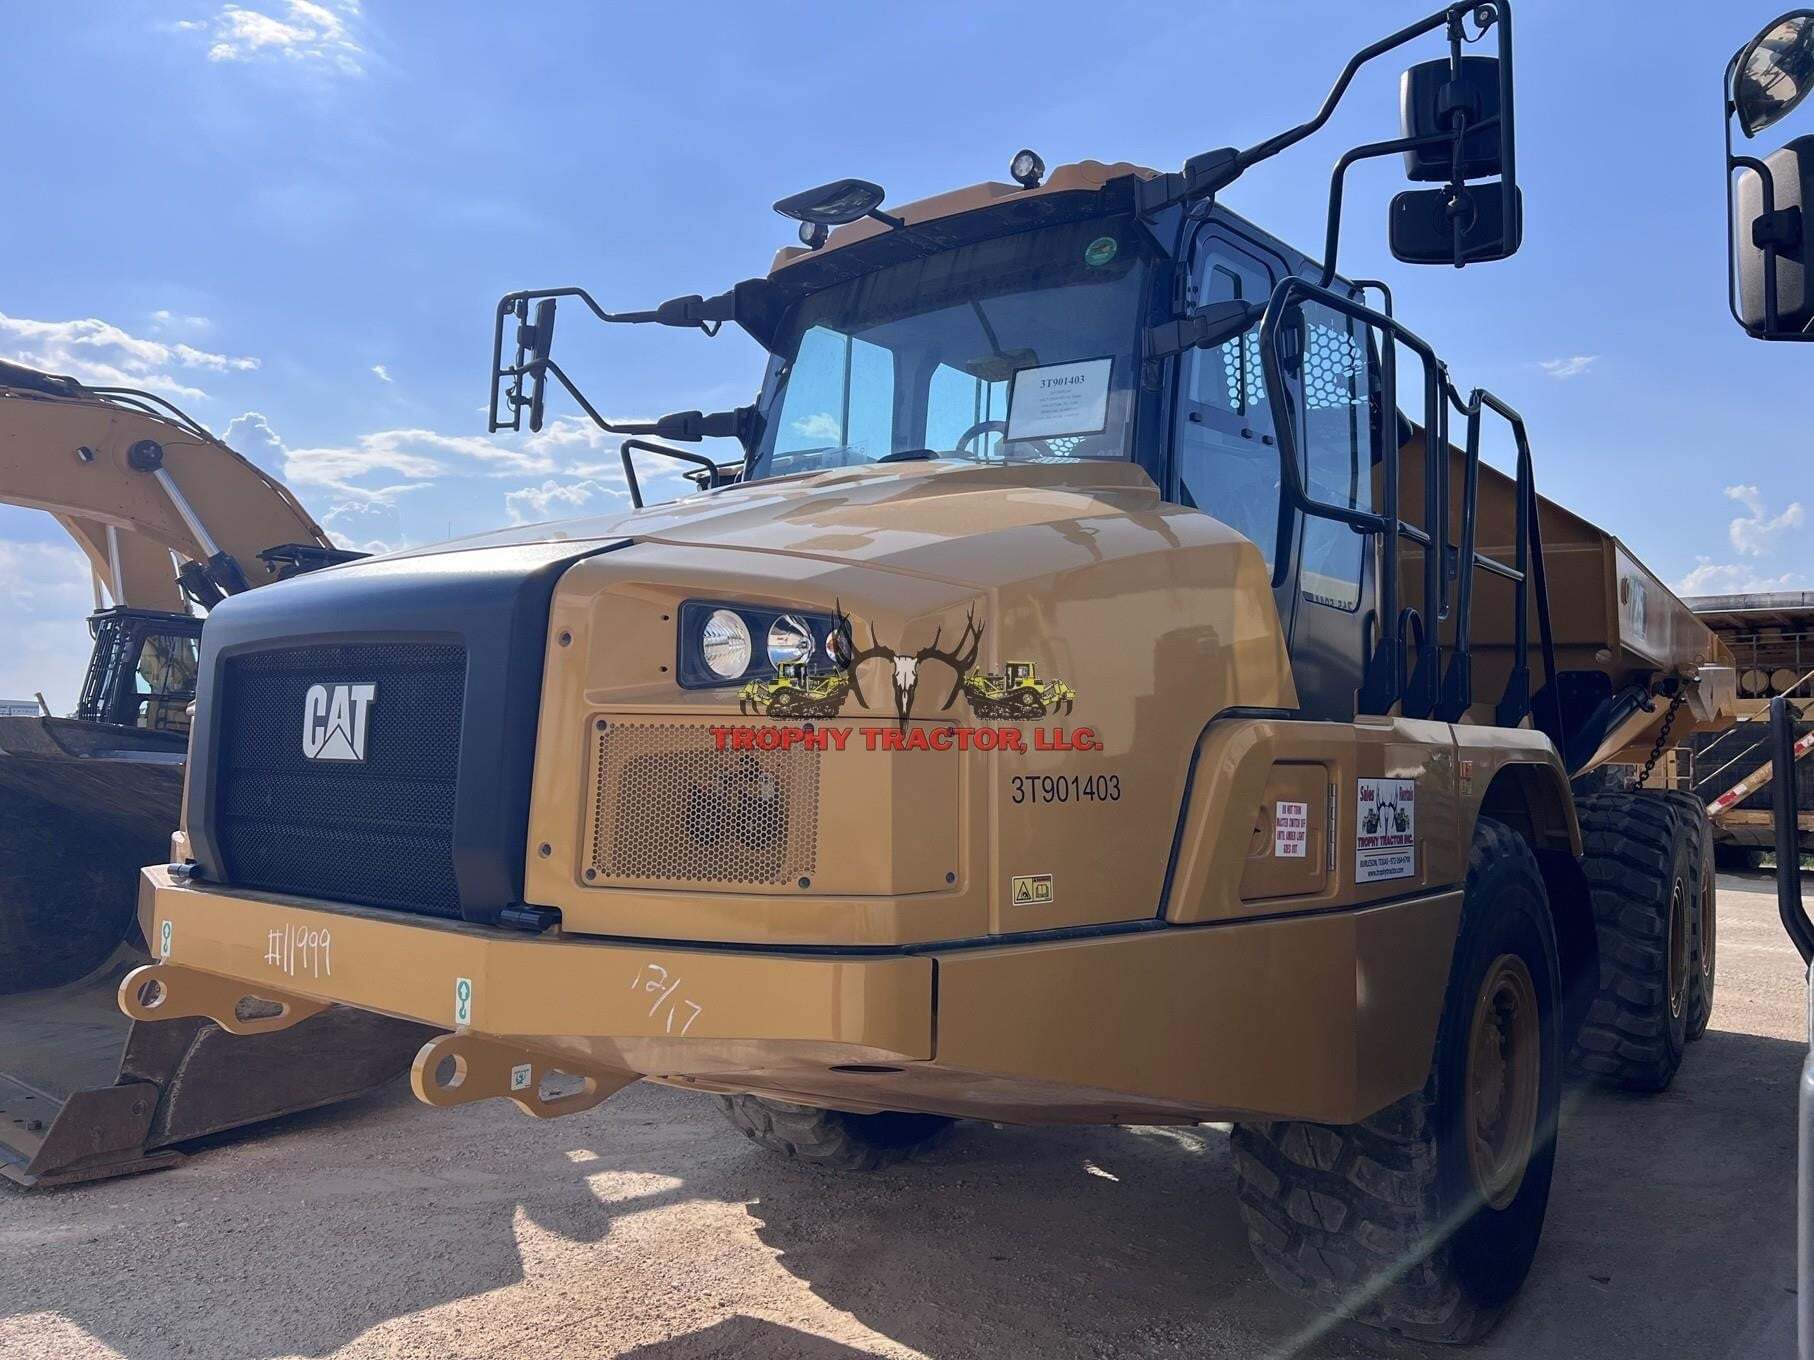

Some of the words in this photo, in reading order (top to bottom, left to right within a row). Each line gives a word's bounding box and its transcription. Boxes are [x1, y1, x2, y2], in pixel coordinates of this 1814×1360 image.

[1040, 375, 1085, 388] 3T901403
[302, 684, 375, 760] CAT
[1011, 775, 1121, 804] 3T901403
[1360, 785, 1375, 802] Sales
[1358, 836, 1379, 848] TROPHY
[1379, 835, 1403, 847] TRACTOR
[264, 923, 331, 978] #11999
[631, 964, 702, 1037] 12/17
